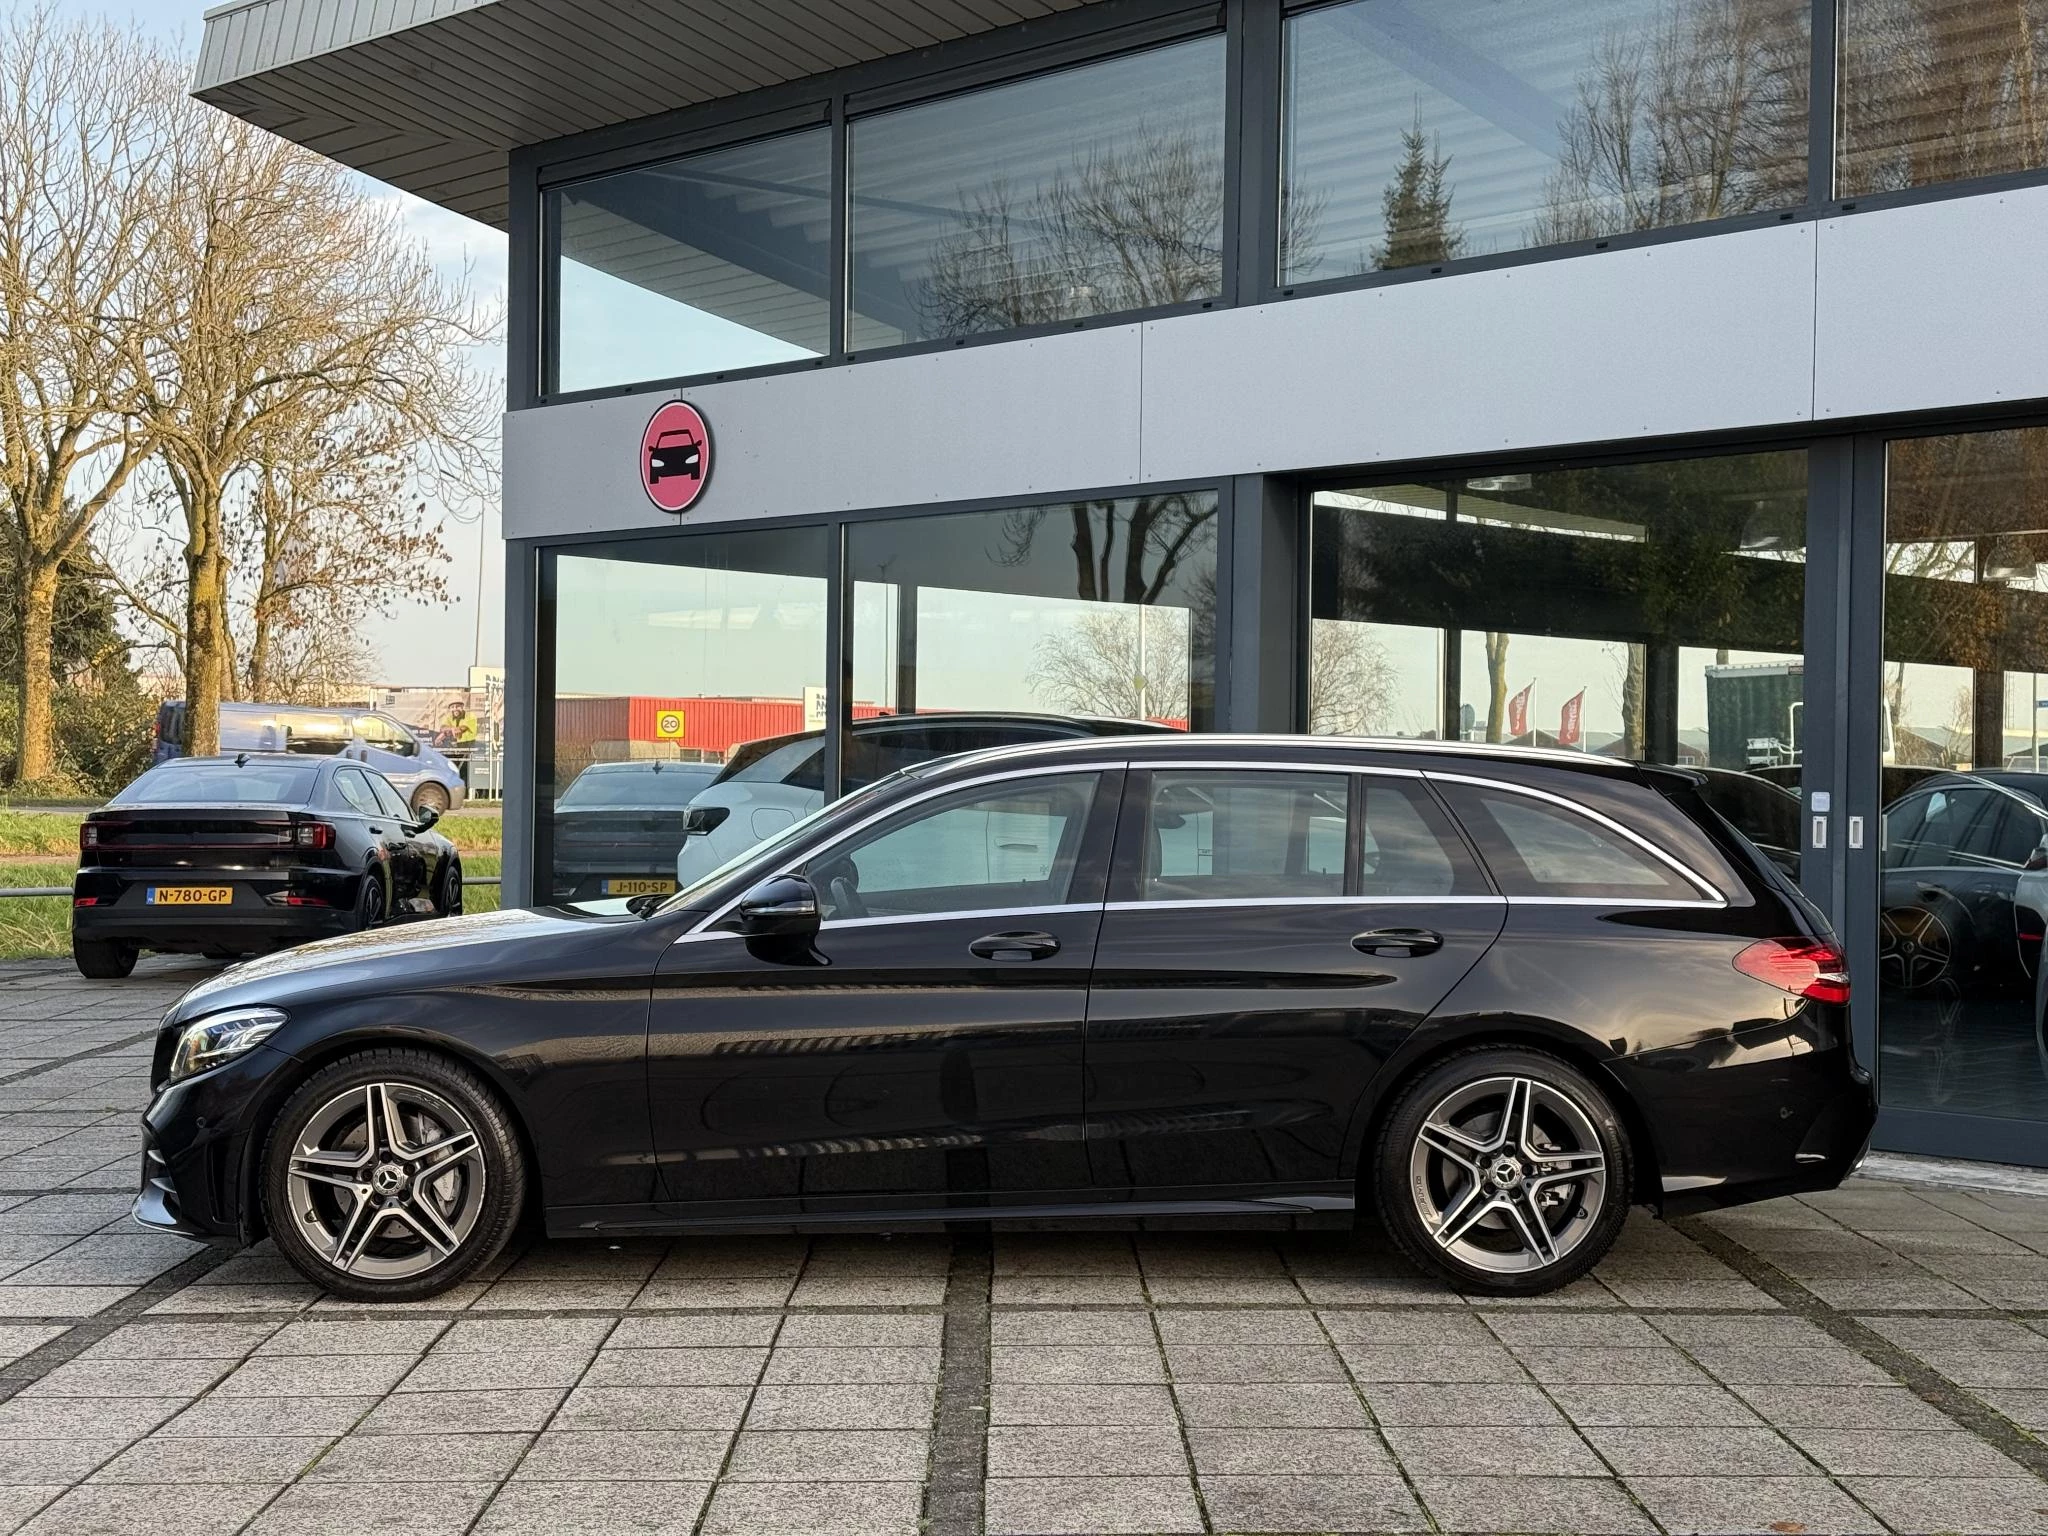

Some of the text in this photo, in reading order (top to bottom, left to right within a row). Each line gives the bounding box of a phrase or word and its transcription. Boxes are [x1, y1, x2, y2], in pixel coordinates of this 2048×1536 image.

[664, 720, 677, 728] 20
[616, 882, 667, 893] J-110-SP
[159, 890, 227, 902] N-780-GP
